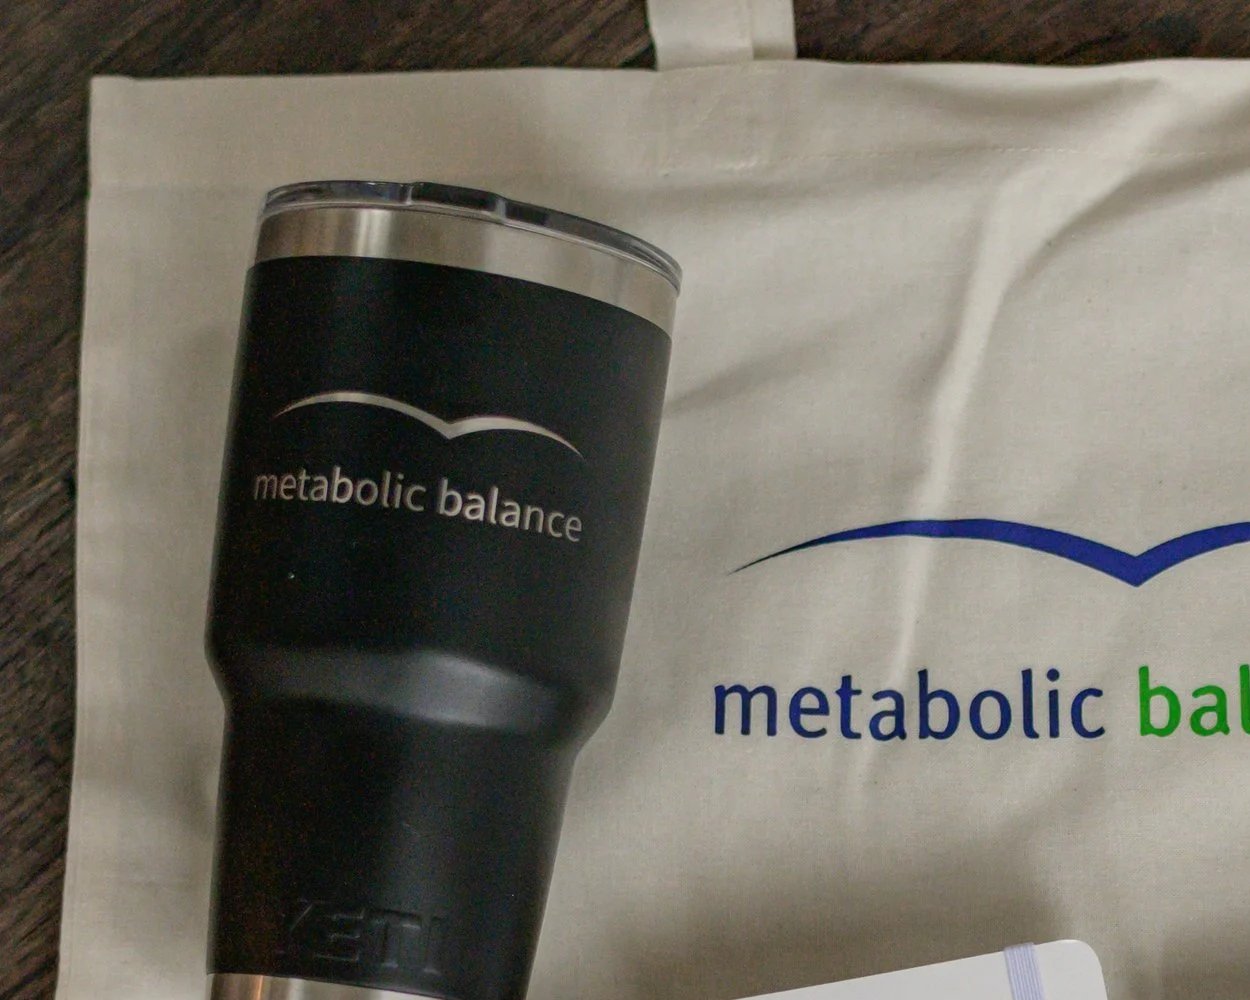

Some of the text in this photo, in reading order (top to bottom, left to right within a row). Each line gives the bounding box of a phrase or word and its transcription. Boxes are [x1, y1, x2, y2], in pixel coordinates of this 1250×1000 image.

[254, 466, 582, 542] metabolic balance
[713, 667, 1106, 742] metabolic
